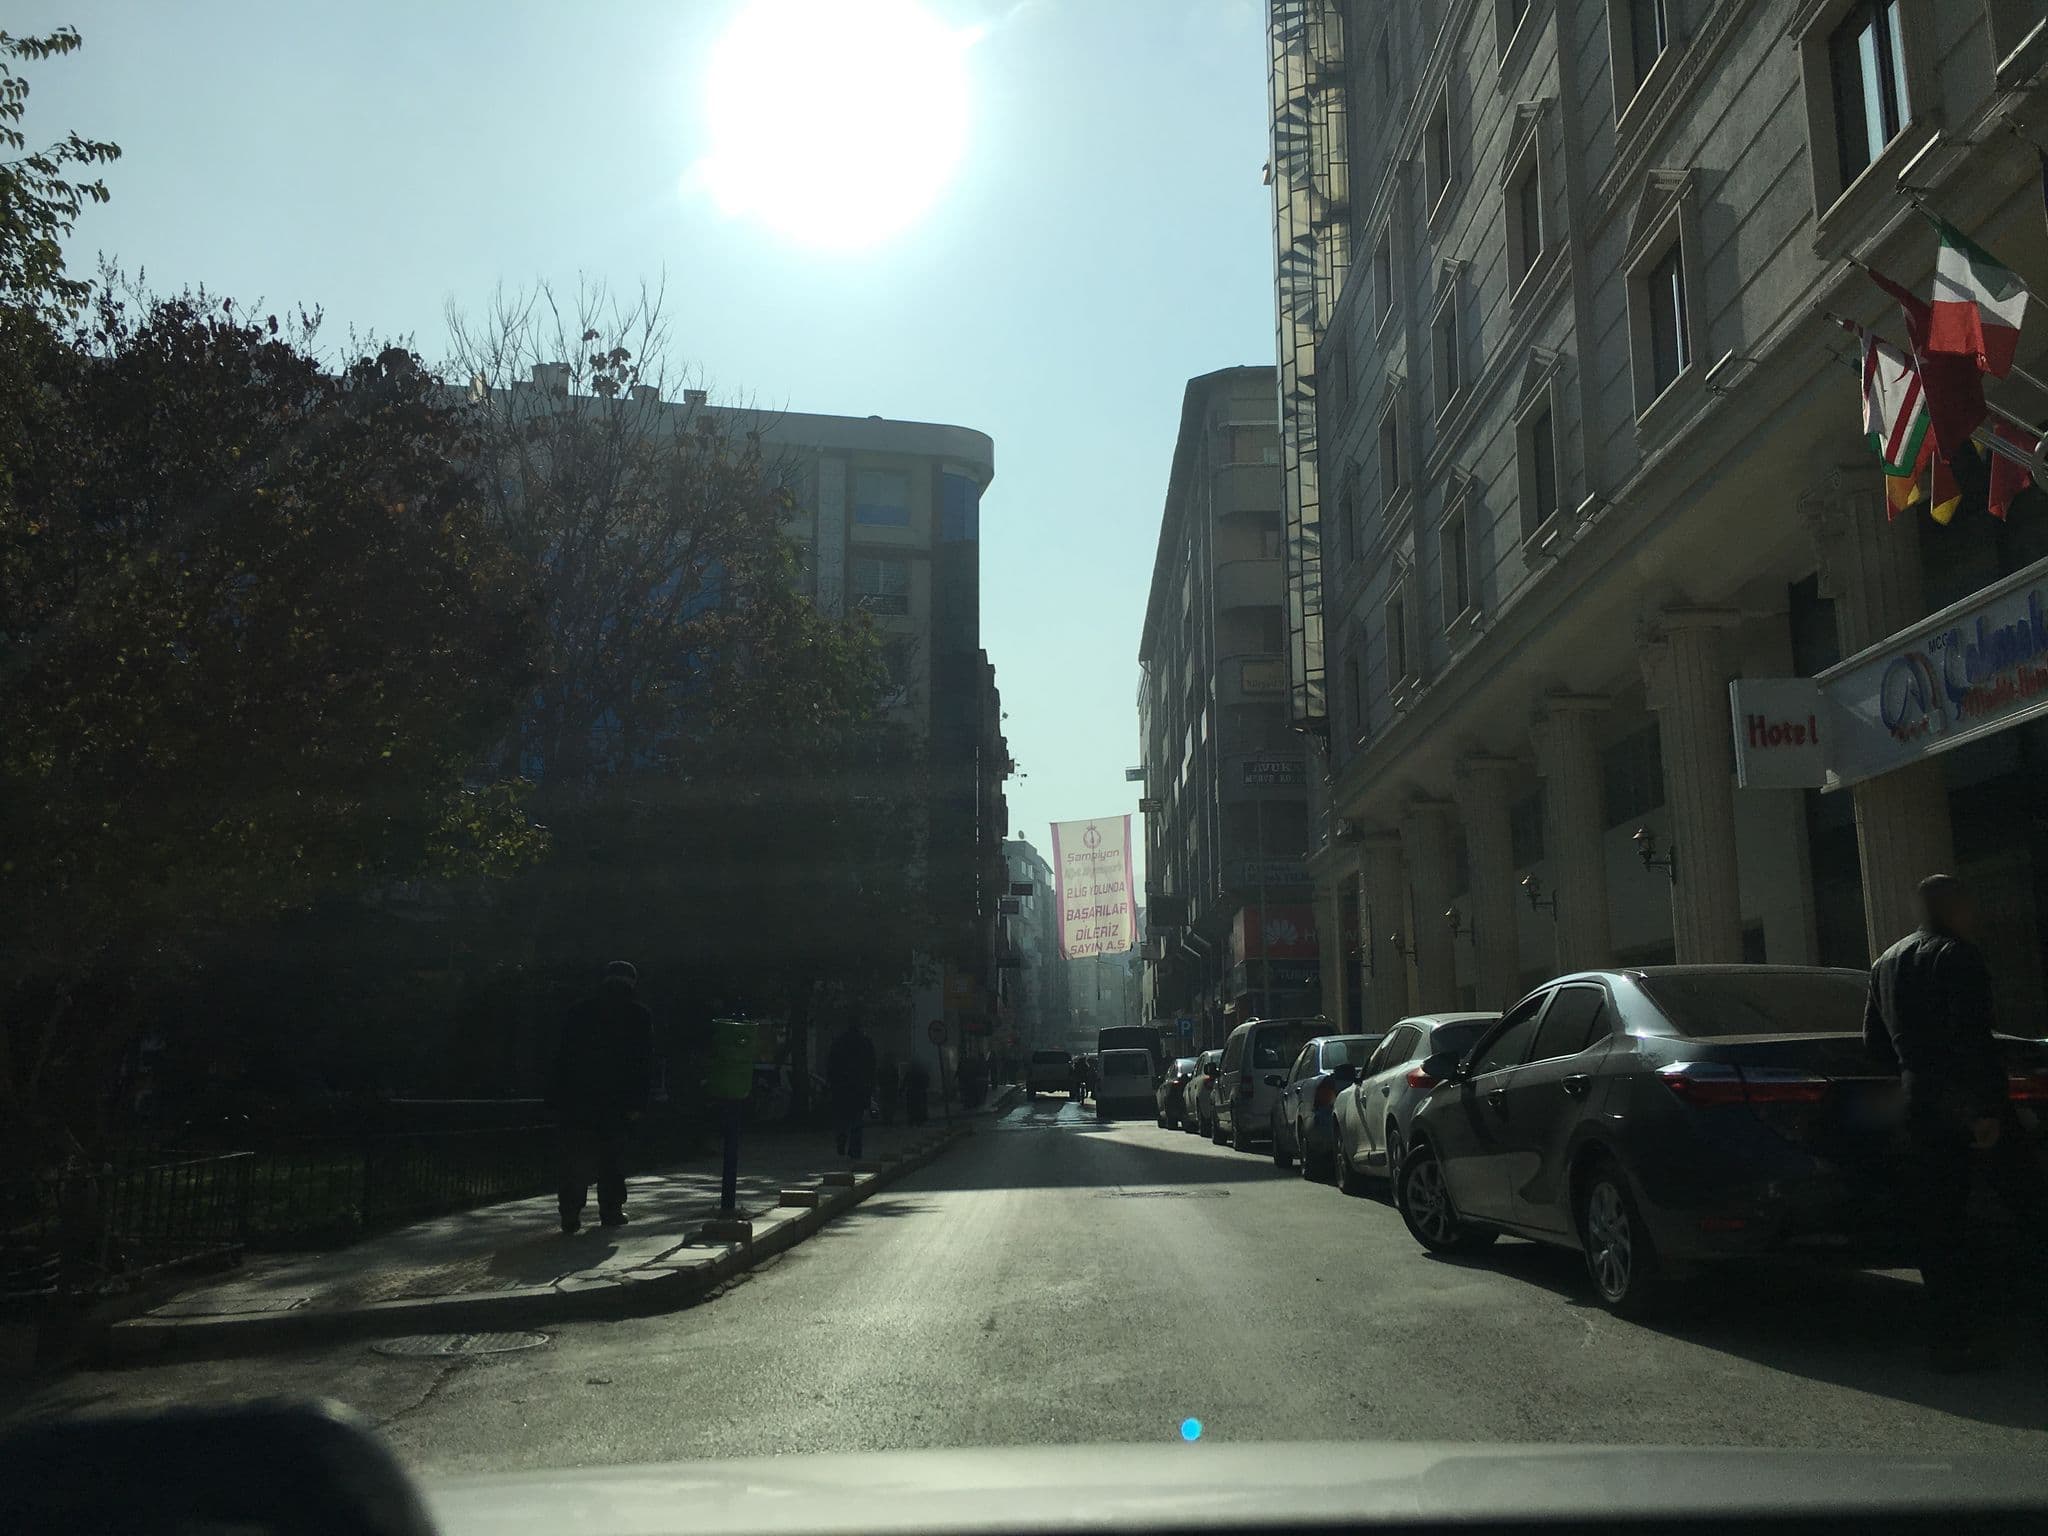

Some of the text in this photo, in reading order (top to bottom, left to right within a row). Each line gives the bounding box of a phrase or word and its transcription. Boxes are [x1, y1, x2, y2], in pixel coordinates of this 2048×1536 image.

[1746, 713, 1819, 748] Hotel
[1067, 849, 1120, 862] Şampiyon
[1089, 882, 1125, 896] YOLUNDA
[1066, 904, 1127, 922] BAŞARILAR
[1076, 923, 1119, 941] DİLERİZ
[1070, 942, 1103, 955] SAYIN
[1181, 1020, 1191, 1035] P
